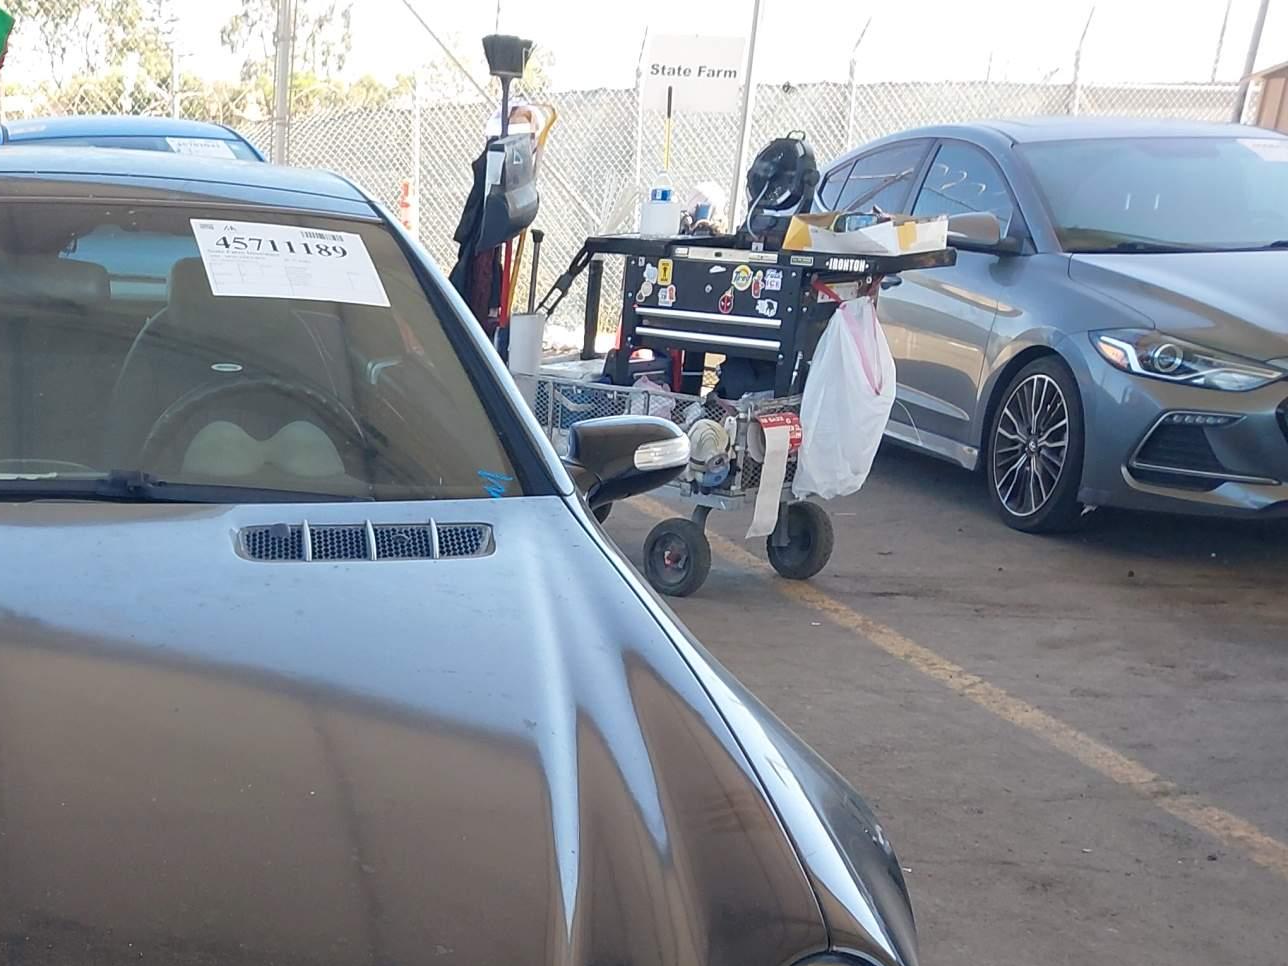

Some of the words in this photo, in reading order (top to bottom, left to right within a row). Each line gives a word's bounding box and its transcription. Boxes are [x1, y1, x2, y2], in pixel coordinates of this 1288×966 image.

[650, 63, 692, 78] State
[697, 65, 737, 79] Farm
[215, 235, 348, 258] 45711189
[828, 257, 867, 273] IRONTON
